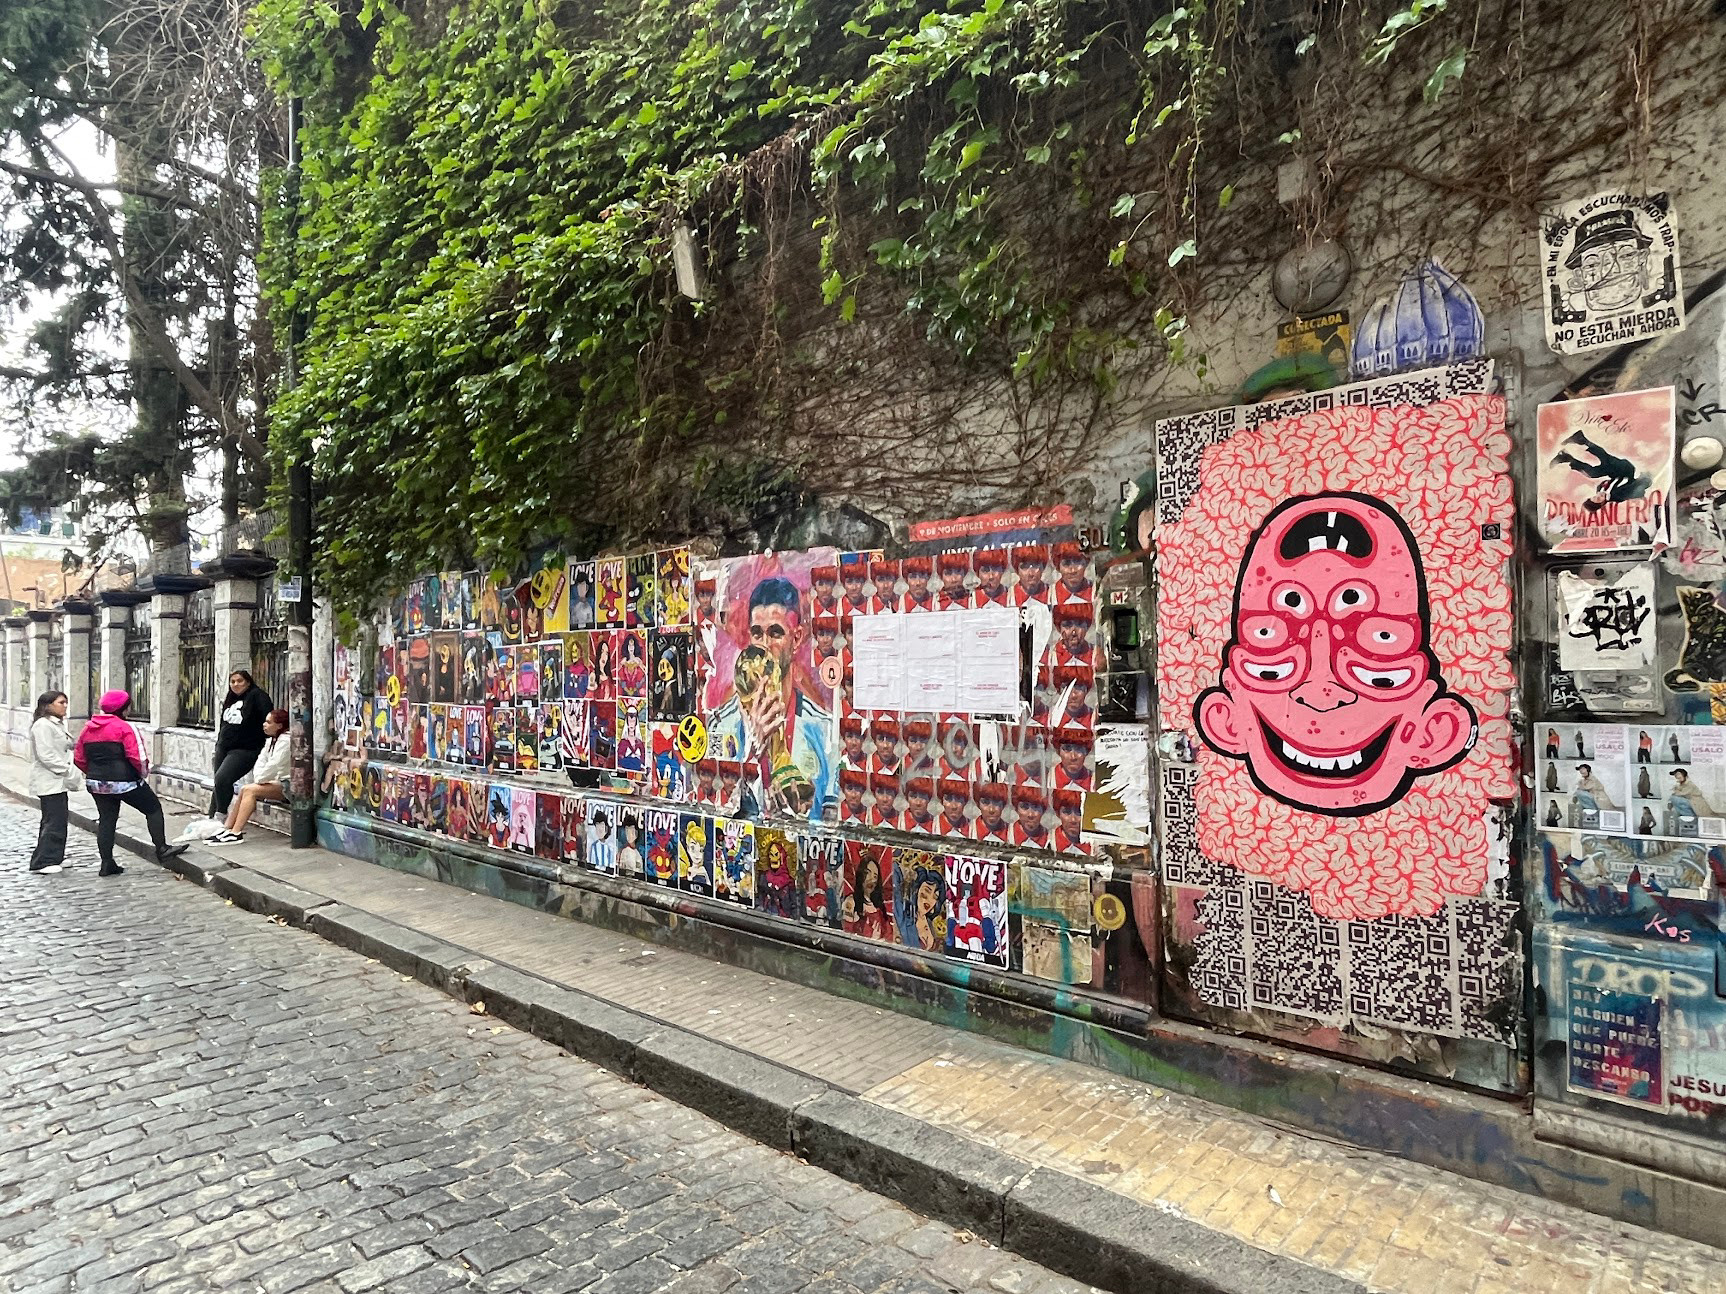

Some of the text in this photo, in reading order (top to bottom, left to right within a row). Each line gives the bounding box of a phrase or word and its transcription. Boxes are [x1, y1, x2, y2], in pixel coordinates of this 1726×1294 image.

[1548, 250, 1560, 263] MI
[1658, 222, 1675, 248] TRAP
[1554, 329, 1575, 342] NO
[1580, 321, 1614, 338] ESTA
[1619, 306, 1677, 329] MIERDA
[1577, 328, 1635, 348] ESCUCHAN
[1640, 317, 1680, 334] AHORA
[992, 516, 1016, 528] SOLO
[1016, 514, 1031, 525] EN
[599, 560, 623, 581] LOVE
[648, 810, 677, 836] LOVE
[723, 820, 745, 839] LOVE
[803, 839, 840, 867] LOVE
[951, 859, 999, 891] LOVE
[1573, 1005, 1635, 1027] ALGUIEN
[1572, 1022, 1601, 1037] QUE
[1608, 1029, 1660, 1048] PUEDE
